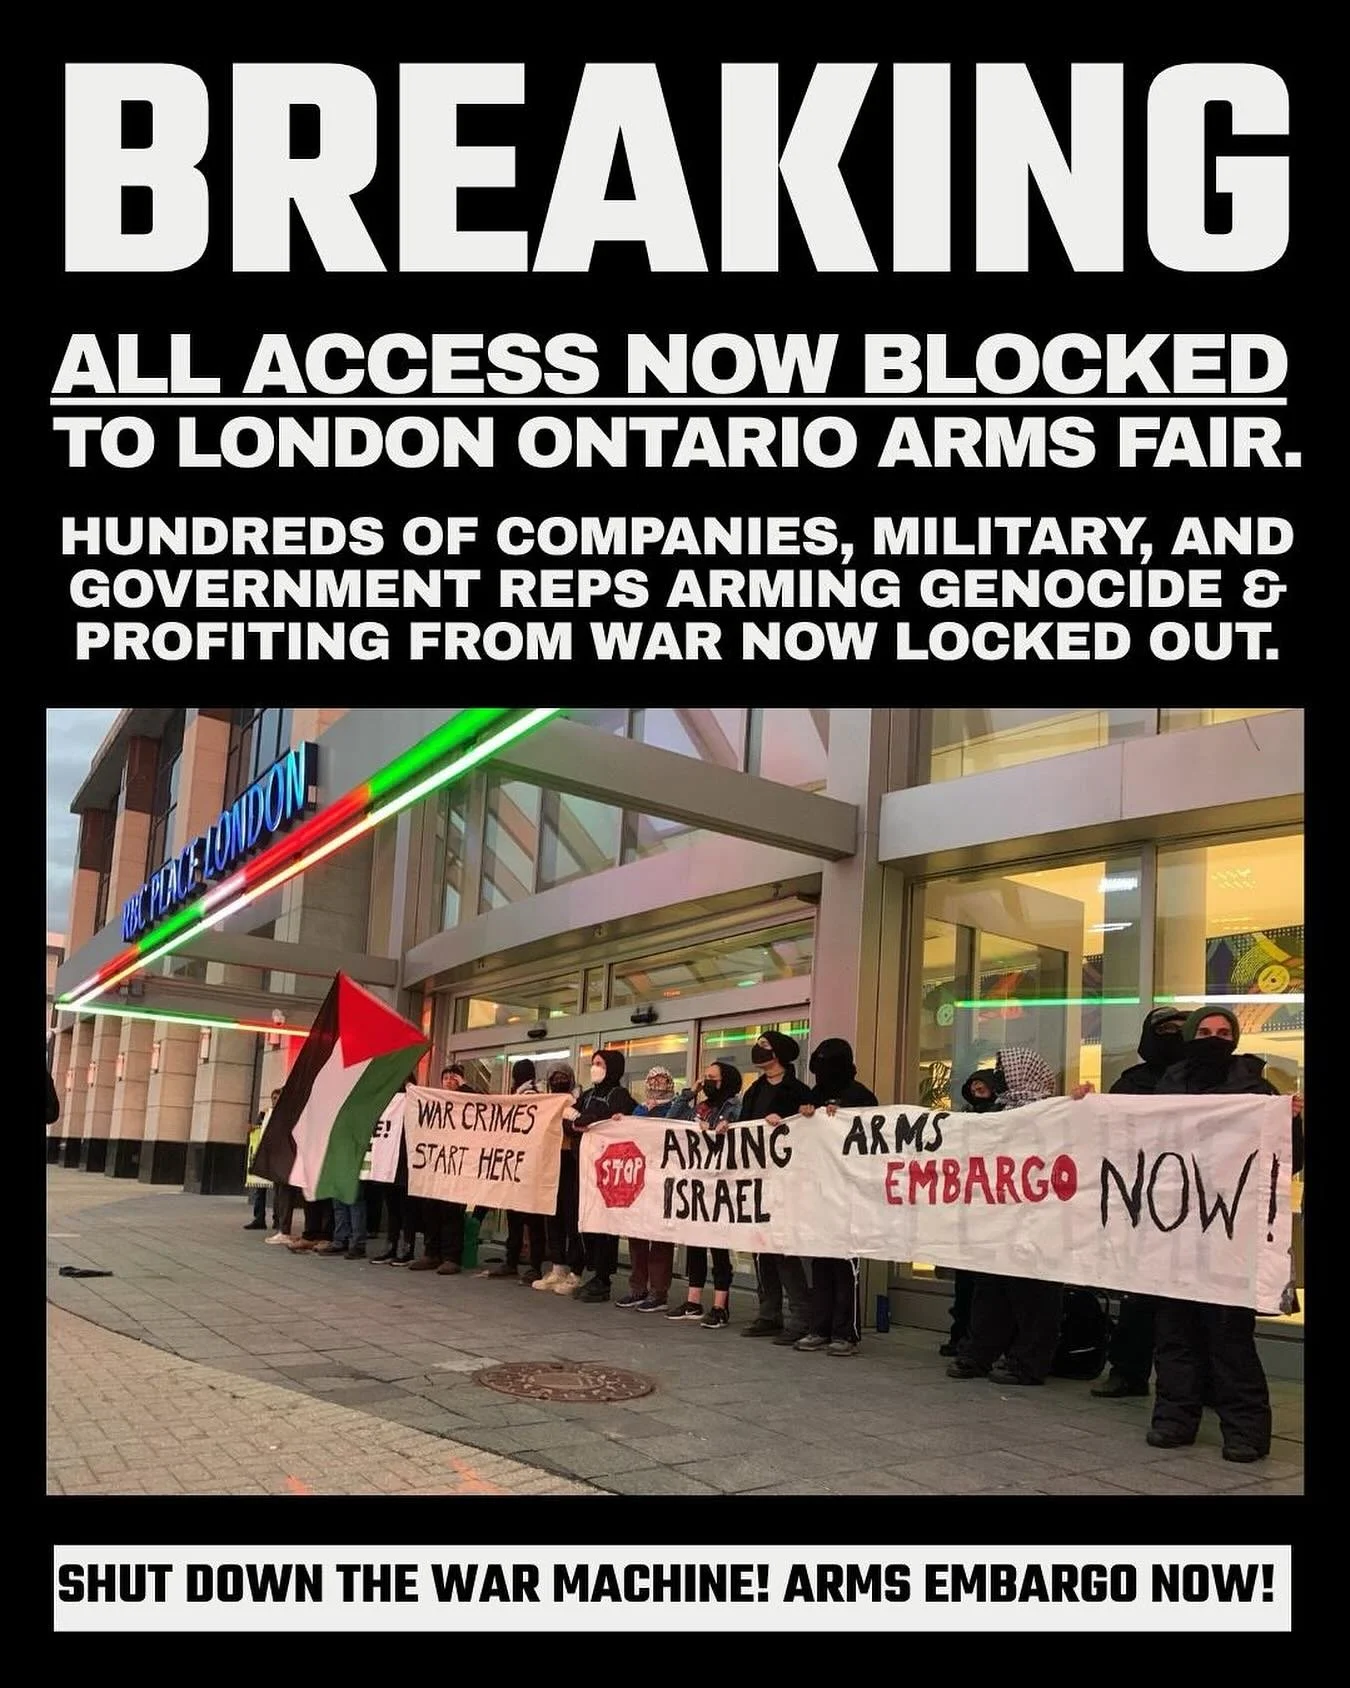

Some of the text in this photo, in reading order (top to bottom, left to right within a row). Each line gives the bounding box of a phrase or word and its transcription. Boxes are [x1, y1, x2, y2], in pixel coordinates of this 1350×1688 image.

[121, 740, 308, 942] RBC PLACE LONDON
[417, 1099, 538, 1135] WAR CRIMES
[842, 1112, 951, 1156] ARMS
[412, 1142, 526, 1183] START HERE
[660, 1124, 792, 1170] ARMING
[601, 1158, 645, 1186] STOP
[663, 1177, 771, 1223] ISRAEL
[884, 1148, 1281, 1243] EMBARGO NOW!
